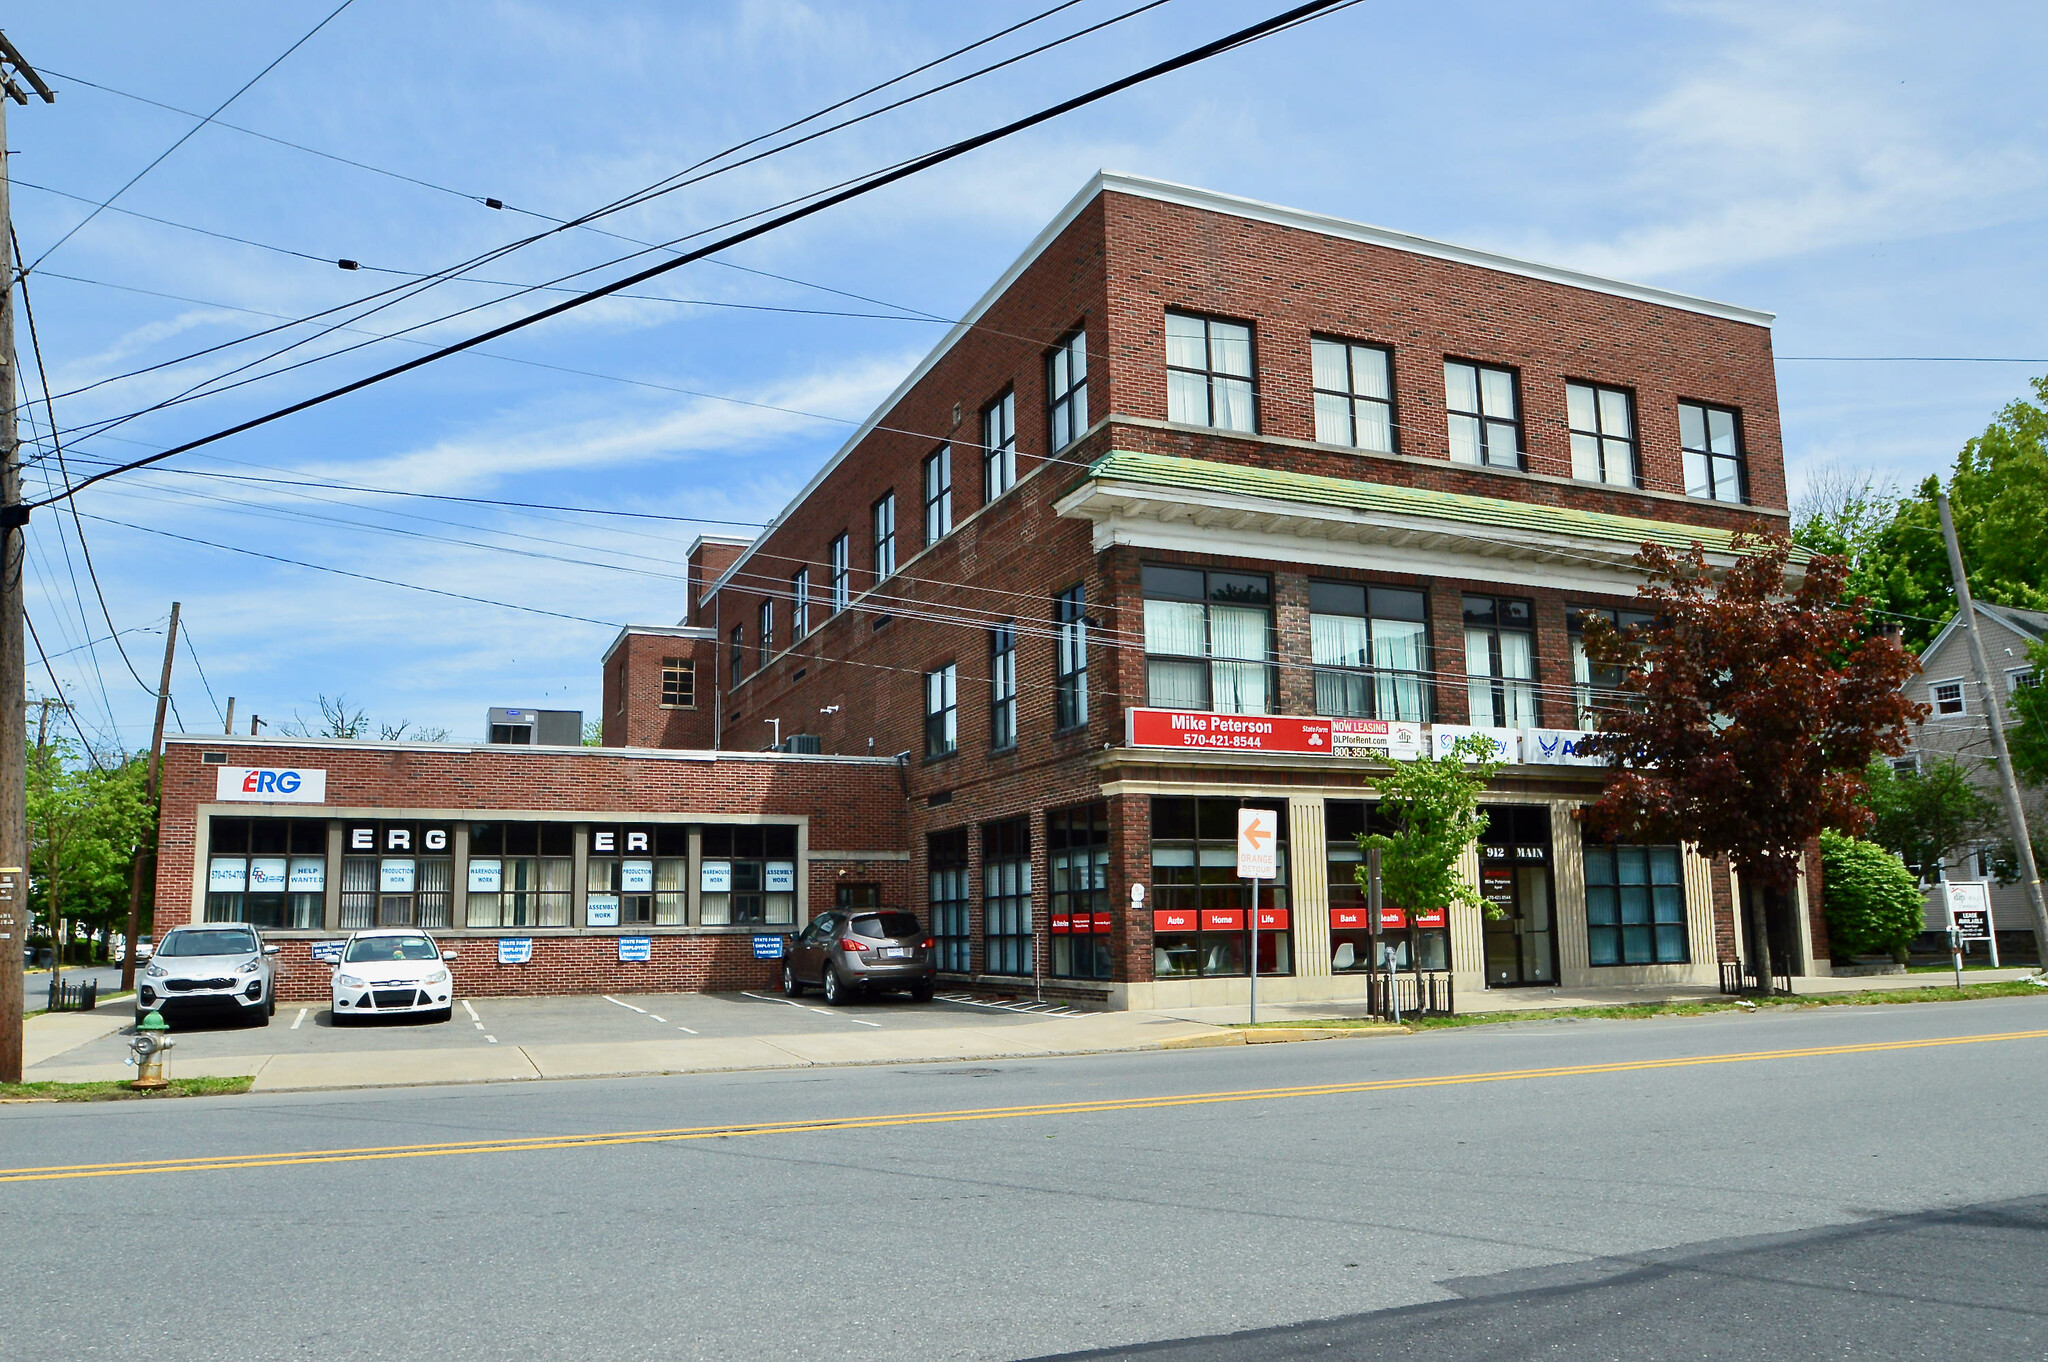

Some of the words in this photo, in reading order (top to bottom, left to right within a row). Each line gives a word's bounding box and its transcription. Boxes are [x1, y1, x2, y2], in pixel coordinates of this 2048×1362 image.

[1171, 714, 1207, 730] Mike
[1210, 716, 1273, 734] Peterson
[1333, 721, 1352, 732] NOW
[1353, 722, 1387, 733] LEASING
[1183, 733, 1262, 748] 570-421-8544
[1333, 735, 1387, 745] DLPforRent.com
[242, 771, 301, 793] ERG
[1486, 847, 1505, 858] 912
[1516, 847, 1543, 858] MAIN
[1240, 853, 1273, 864] ORANGE
[1242, 865, 1271, 873] DETOUR
[1167, 916, 1185, 925] Auto
[1211, 915, 1233, 924] Home
[1261, 914, 1275, 923] Life
[1340, 914, 1357, 923] Bank
